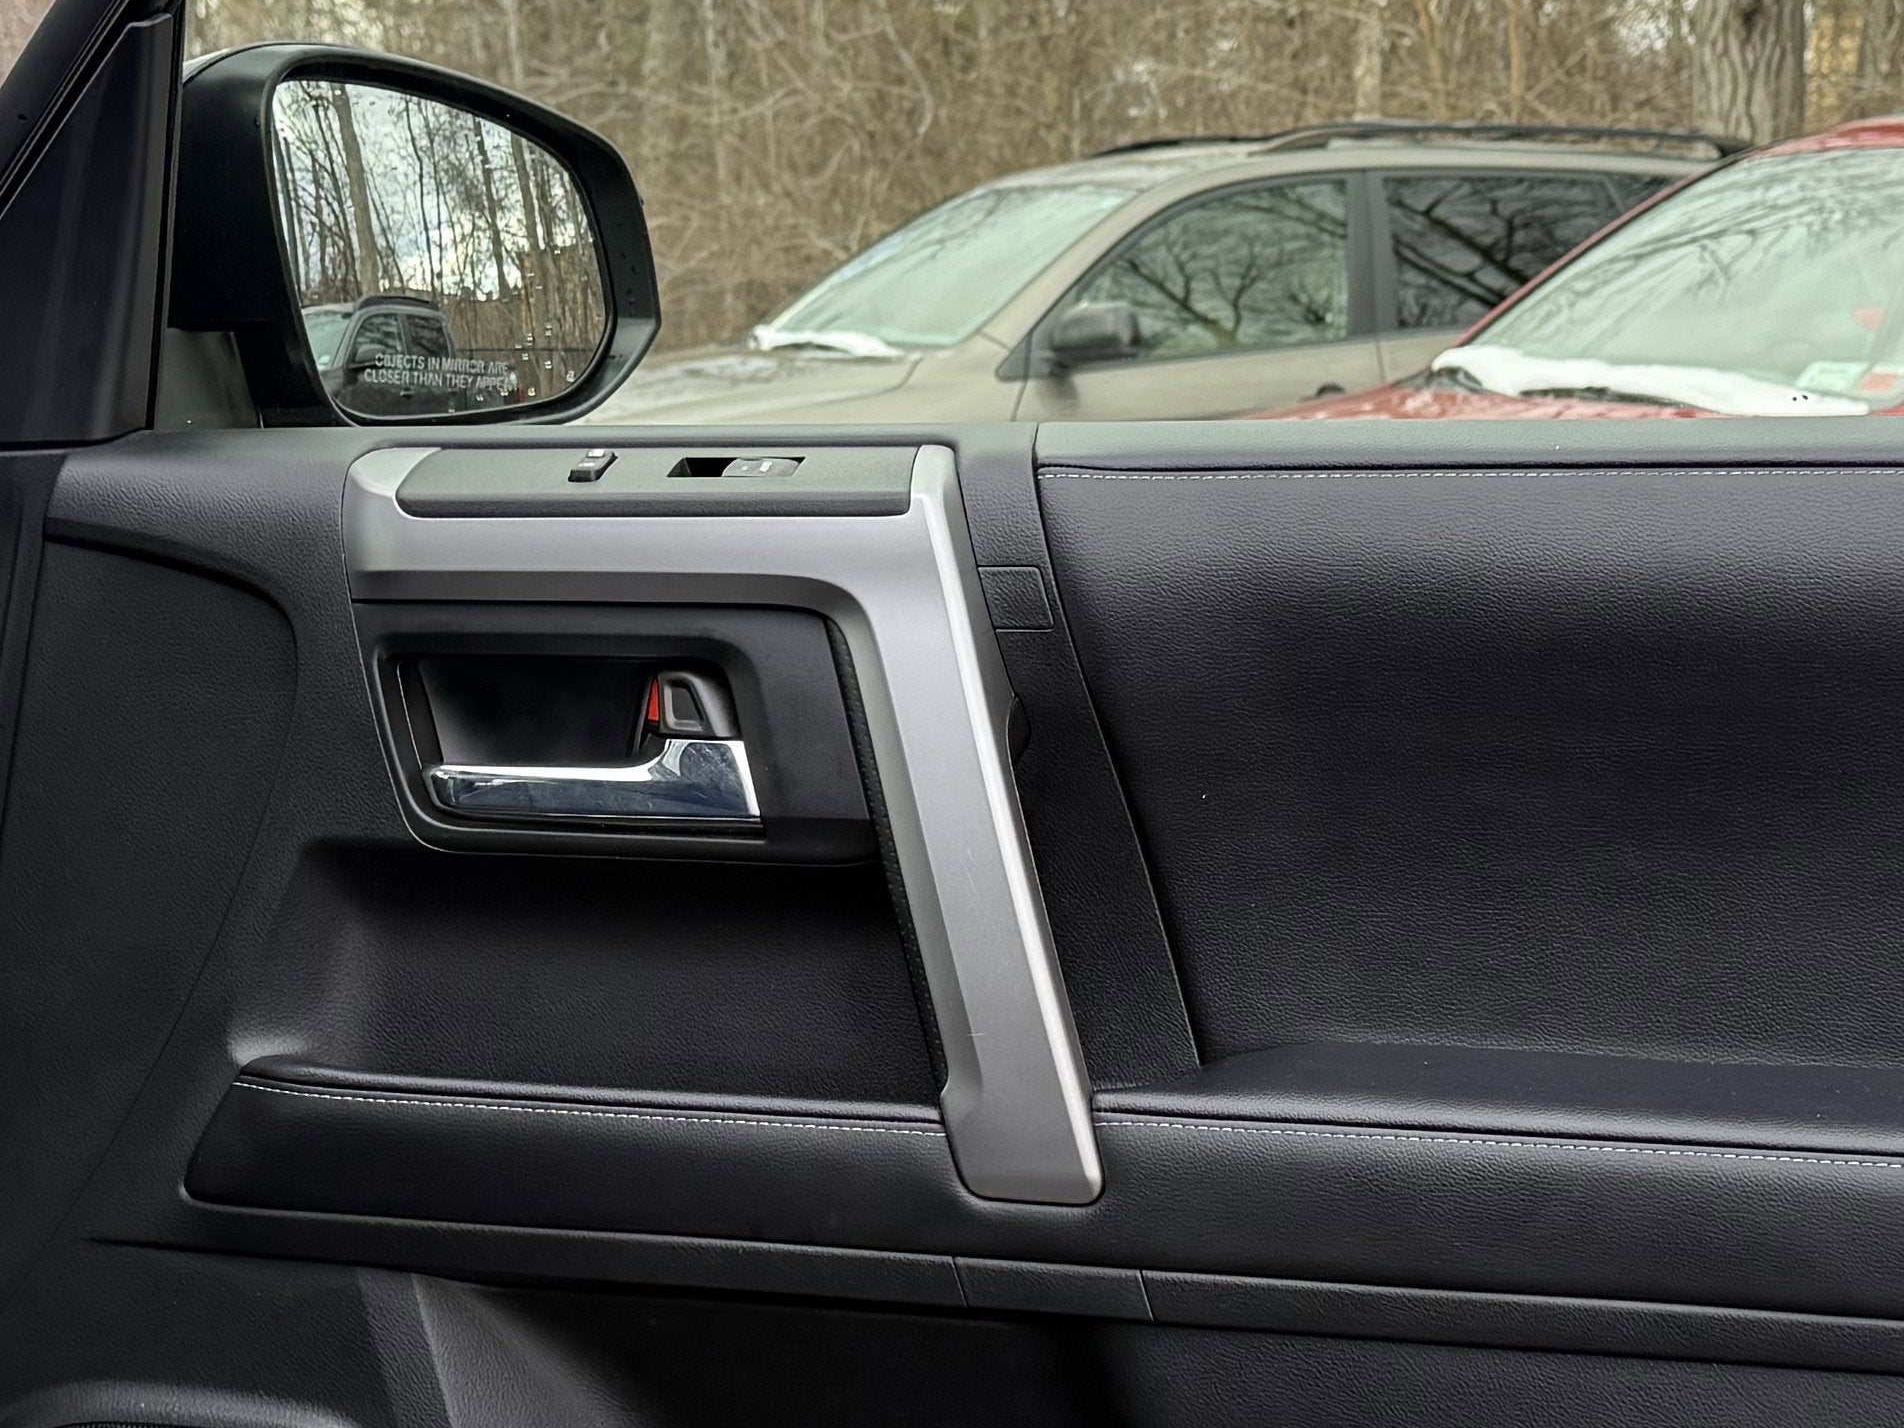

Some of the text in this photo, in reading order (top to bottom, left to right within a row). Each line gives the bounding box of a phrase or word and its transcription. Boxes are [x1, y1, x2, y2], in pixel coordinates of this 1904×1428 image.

[375, 352, 510, 376] OBJECTS IN MIRROR ARE
[363, 367, 410, 385] CLOSER
[413, 371, 443, 387] THAN
[446, 373, 474, 389] THEY
